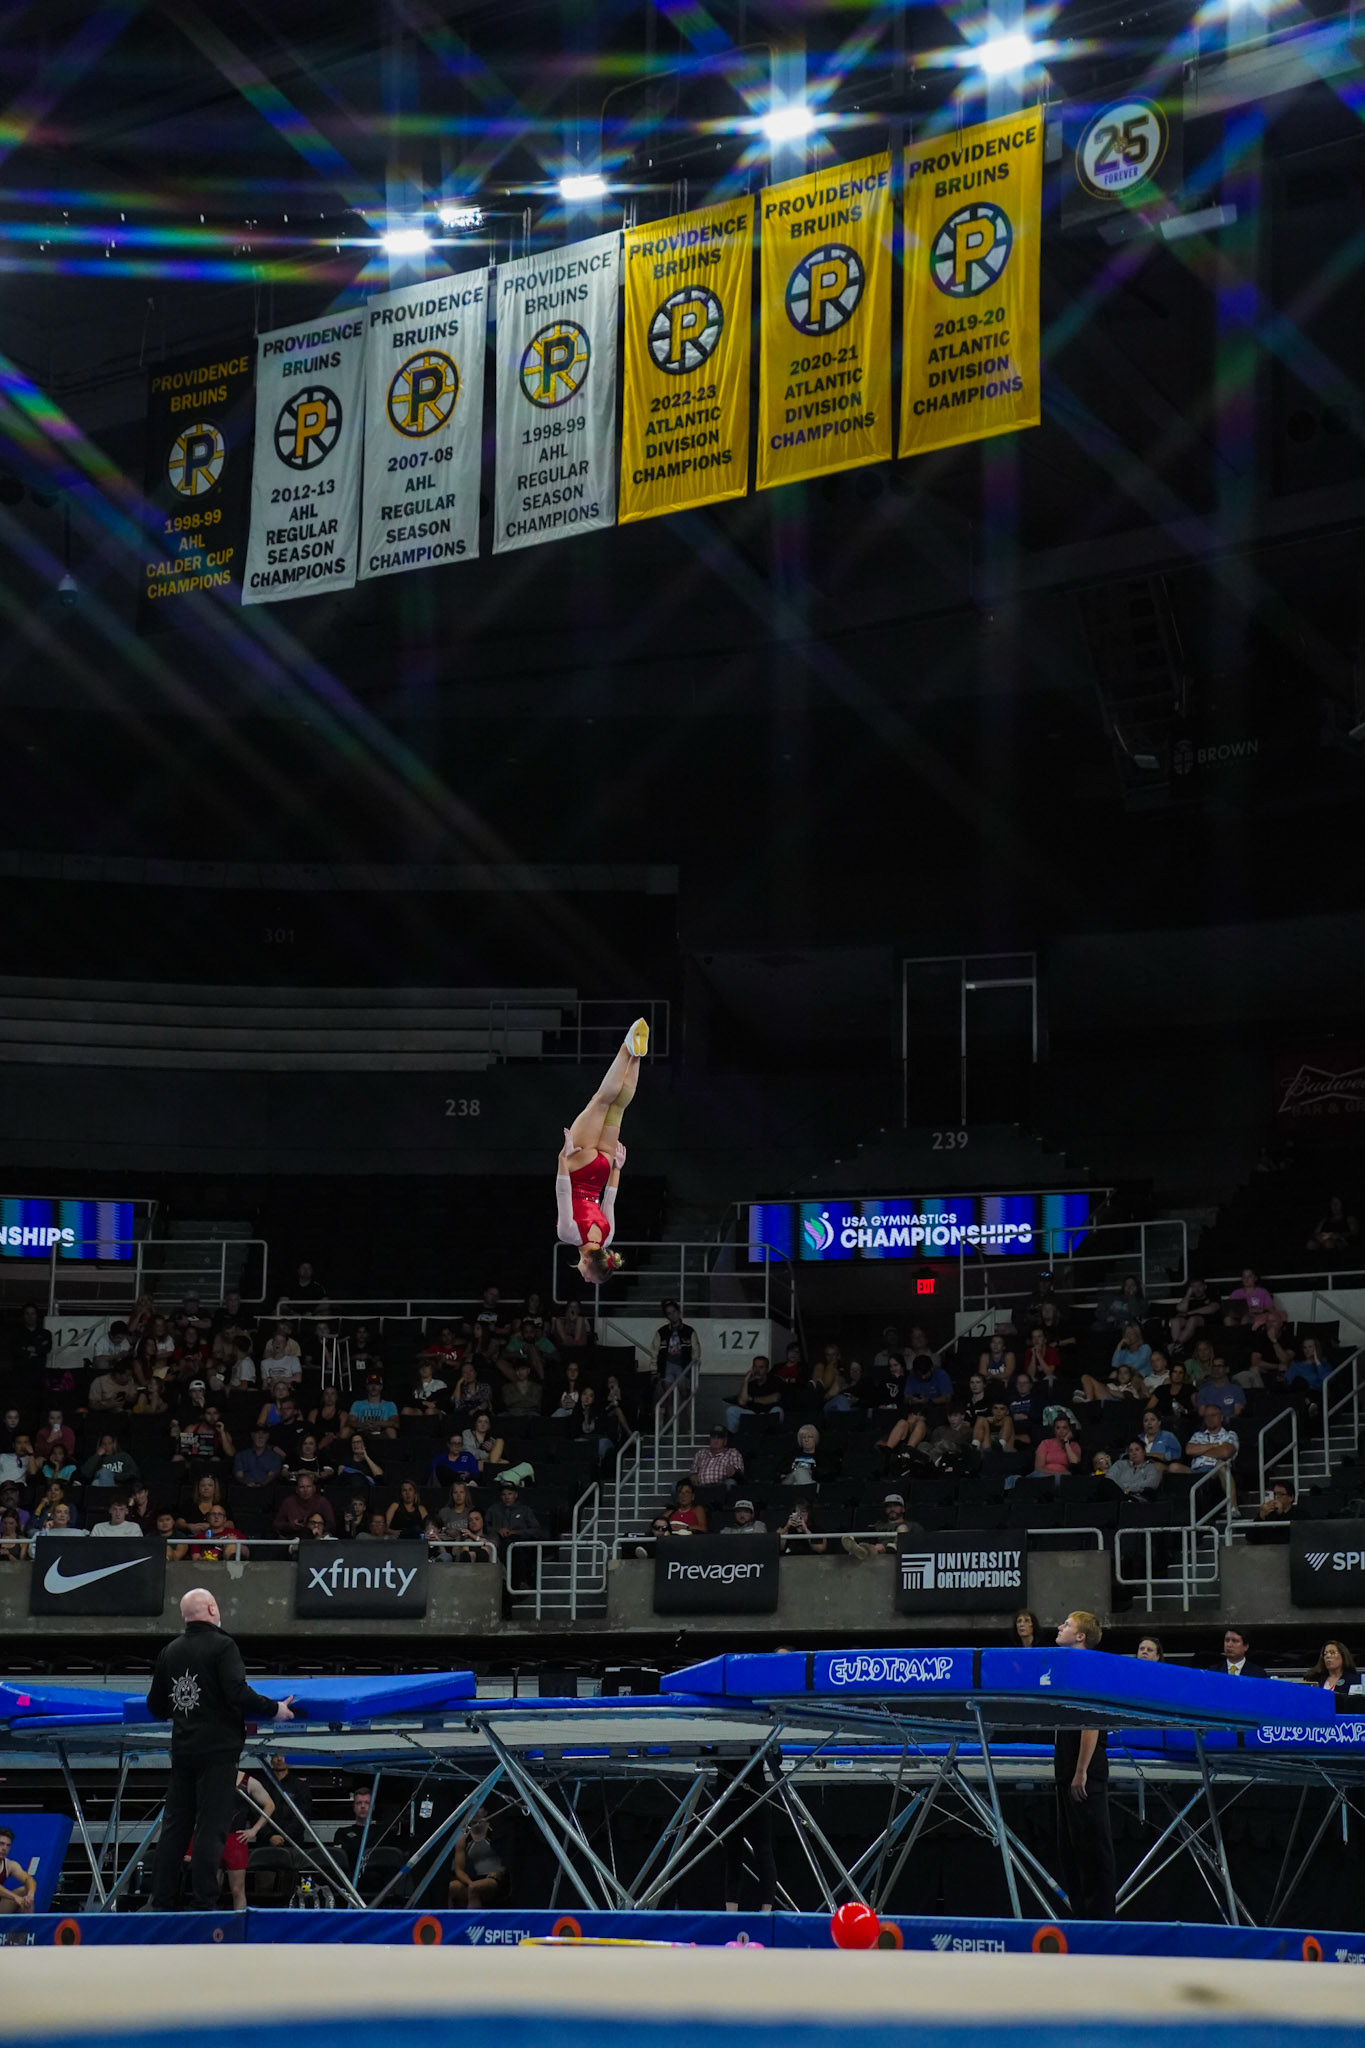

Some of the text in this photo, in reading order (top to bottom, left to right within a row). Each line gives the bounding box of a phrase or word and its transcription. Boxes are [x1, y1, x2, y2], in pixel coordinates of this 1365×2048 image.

[909, 126, 1036, 179] PROVIDENCE
[1094, 114, 1149, 176] 25
[935, 163, 1010, 198] BRUINS
[1104, 167, 1138, 185] FOREVER
[766, 171, 888, 219] PROVIDENCE
[790, 205, 862, 239] BRUINS
[629, 214, 747, 260] PROVIDENCE
[503, 252, 612, 295] PROVIDENCE
[653, 249, 721, 280] BRUINS
[370, 287, 484, 328] PROVIDENCE
[525, 284, 589, 315] BRUINS
[392, 320, 459, 348] BRUINS
[934, 307, 1005, 338] 2019-20
[263, 320, 363, 358] PROVIDENCE
[928, 330, 1010, 364] ATLANTIC
[152, 356, 249, 392] PROVIDENCE
[282, 352, 341, 377] BRUINS
[790, 345, 858, 375] 2020-21
[928, 355, 1010, 388] DIVISION
[651, 384, 717, 413] 2022-23
[785, 368, 862, 400] ATLANTIC
[913, 376, 1023, 416] CHAMPIONS
[170, 385, 228, 413] BRUINS
[785, 392, 862, 424] DIVISION
[522, 416, 586, 445] 1998-99
[645, 406, 721, 436] ATLANTIC
[770, 412, 875, 450] CHAMPIONS
[539, 444, 568, 462] AHL
[646, 429, 720, 459] DIVISION
[387, 446, 453, 472] 2007-08
[632, 450, 732, 484] CHAMPIONS
[405, 475, 436, 493] AHL
[517, 460, 589, 490] REGULAR
[271, 479, 335, 503] 2012-13
[522, 484, 584, 511] SEASON
[164, 509, 222, 534] 1998-99
[289, 503, 318, 522] AHL
[380, 494, 456, 520] REGULAR
[506, 503, 600, 538] CHAMPIONS
[179, 535, 206, 552] AHL
[266, 519, 338, 546] REGULAR
[386, 518, 451, 544] SEASON
[146, 548, 234, 578] CALDER CUP
[267, 540, 334, 565] SEASON
[369, 540, 466, 571] CHAMPIONS
[147, 570, 231, 599] CHAMPIONS
[250, 558, 346, 589] CHAMPIONS
[1197, 739, 1259, 764] BROWN
[445, 1099, 481, 1116] 238
[932, 1131, 969, 1150] 239
[842, 1213, 957, 1228] USA GYMNASTICS
[840, 1223, 1032, 1249] CHAMPIONSHIPS
[917, 1278, 935, 1294] EXIT
[54, 1328, 96, 1347] 127
[719, 1330, 760, 1349] 127
[937, 1550, 1021, 1570] UNIVERSITY
[1332, 1551, 1365, 1571] SPI
[307, 1558, 418, 1597] xfinity
[937, 1569, 1021, 1589] ORTHOPEDICS
[484, 1929, 530, 1944] SPIETH
[952, 1938, 1005, 1952] SPIETH
